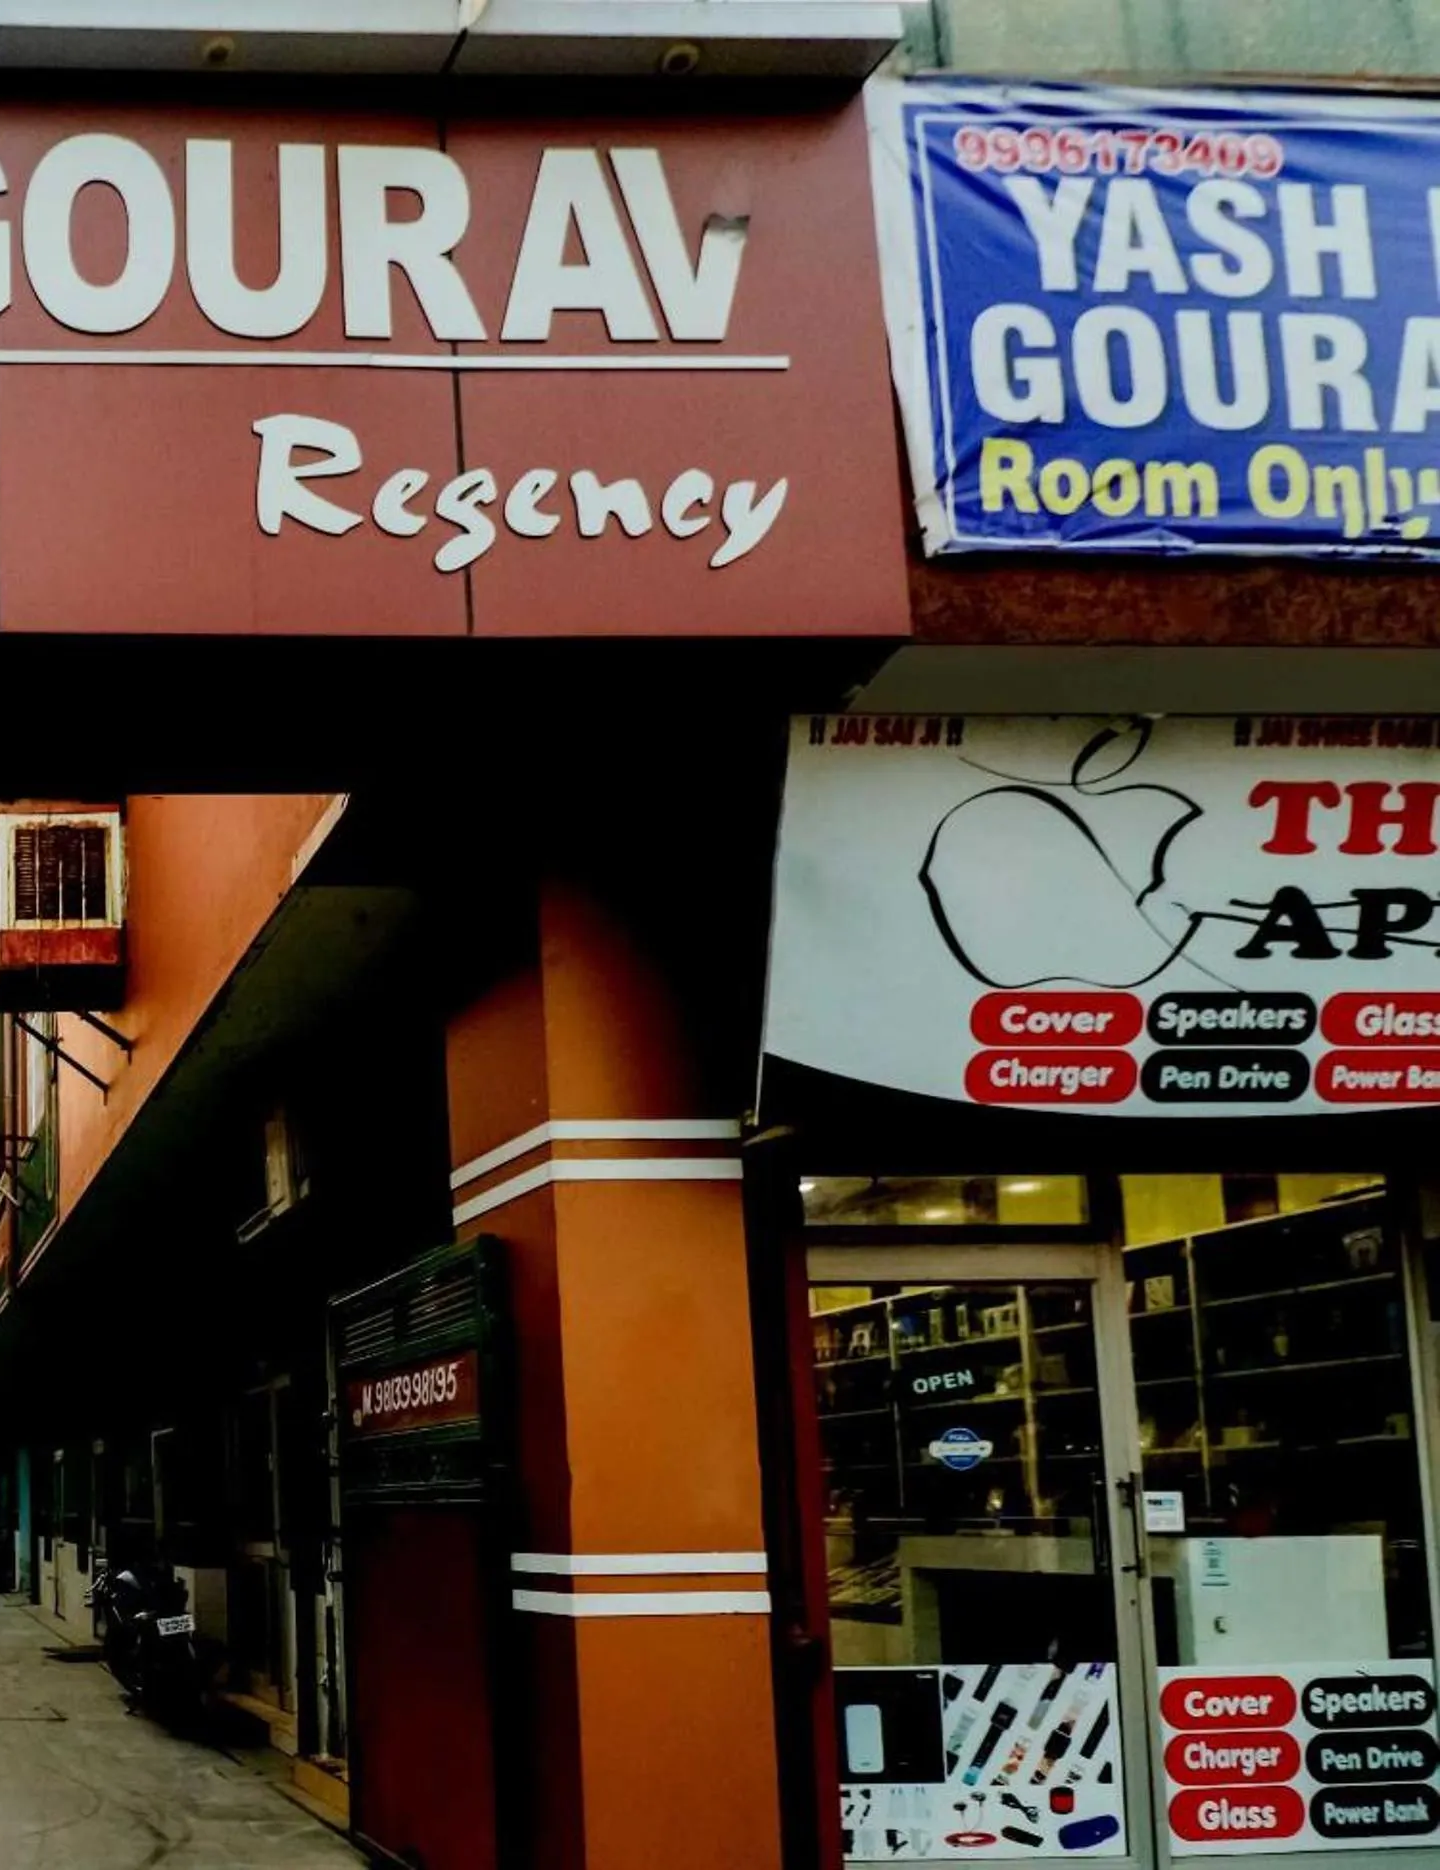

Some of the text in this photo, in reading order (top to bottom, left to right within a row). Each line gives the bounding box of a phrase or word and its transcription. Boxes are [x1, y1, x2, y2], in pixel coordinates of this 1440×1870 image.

[1002, 176, 1377, 299] YASH
[252, 414, 789, 572] Regency
[980, 437, 1219, 517] Room
[1000, 1004, 1114, 1034] Cover
[1157, 1001, 1308, 1038] Speakers
[989, 1058, 1115, 1095] Charger
[1159, 1063, 1291, 1090] Pen Drive
[1331, 1064, 1401, 1090] Power
[912, 1368, 974, 1395] OPEN
[1184, 1690, 1273, 1718] Cover
[1309, 1683, 1427, 1722] Speakers
[1183, 1740, 1282, 1777] Charger
[1320, 1744, 1425, 1771] Pen Drive
[1197, 1798, 1278, 1831] Glass
[1323, 1797, 1430, 1826] Power Bank
